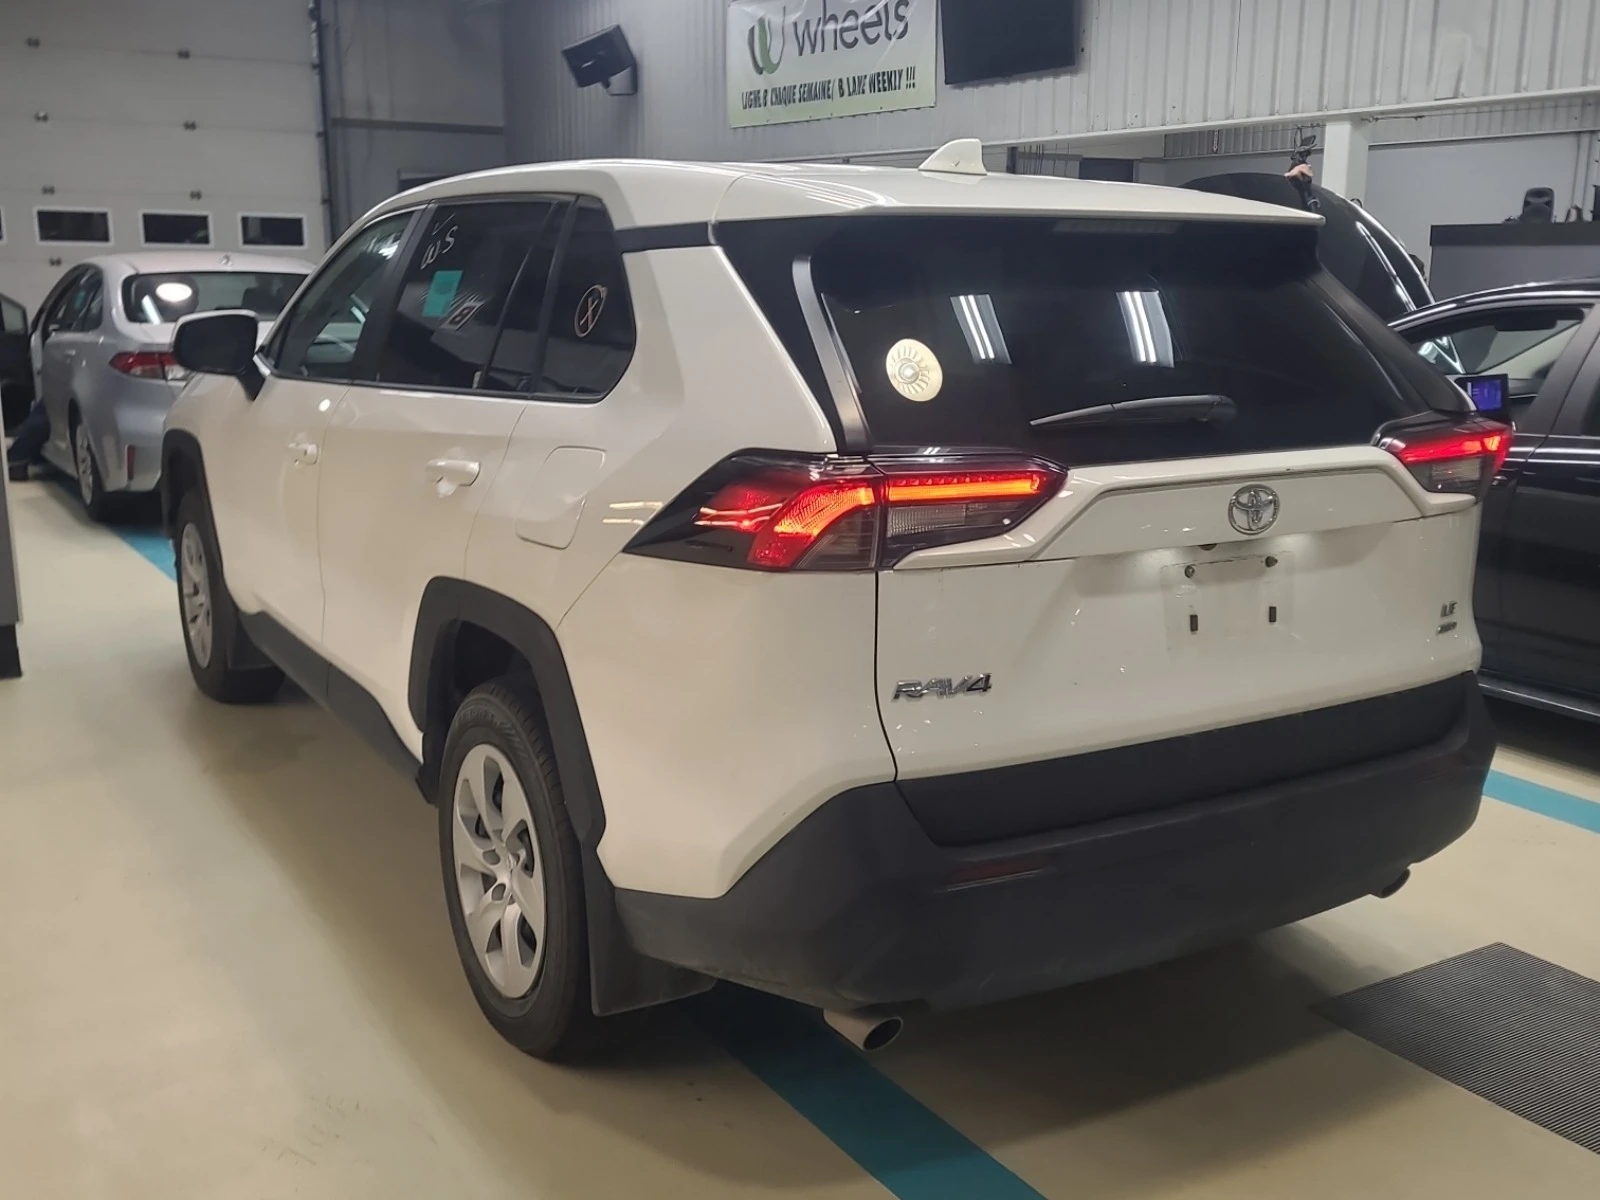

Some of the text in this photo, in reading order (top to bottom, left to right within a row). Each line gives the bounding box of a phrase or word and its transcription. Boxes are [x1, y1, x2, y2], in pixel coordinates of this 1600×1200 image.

[770, 84, 797, 107] CHAQUE
[869, 69, 904, 94] WEEKLY
[892, 672, 992, 701] RAV4
